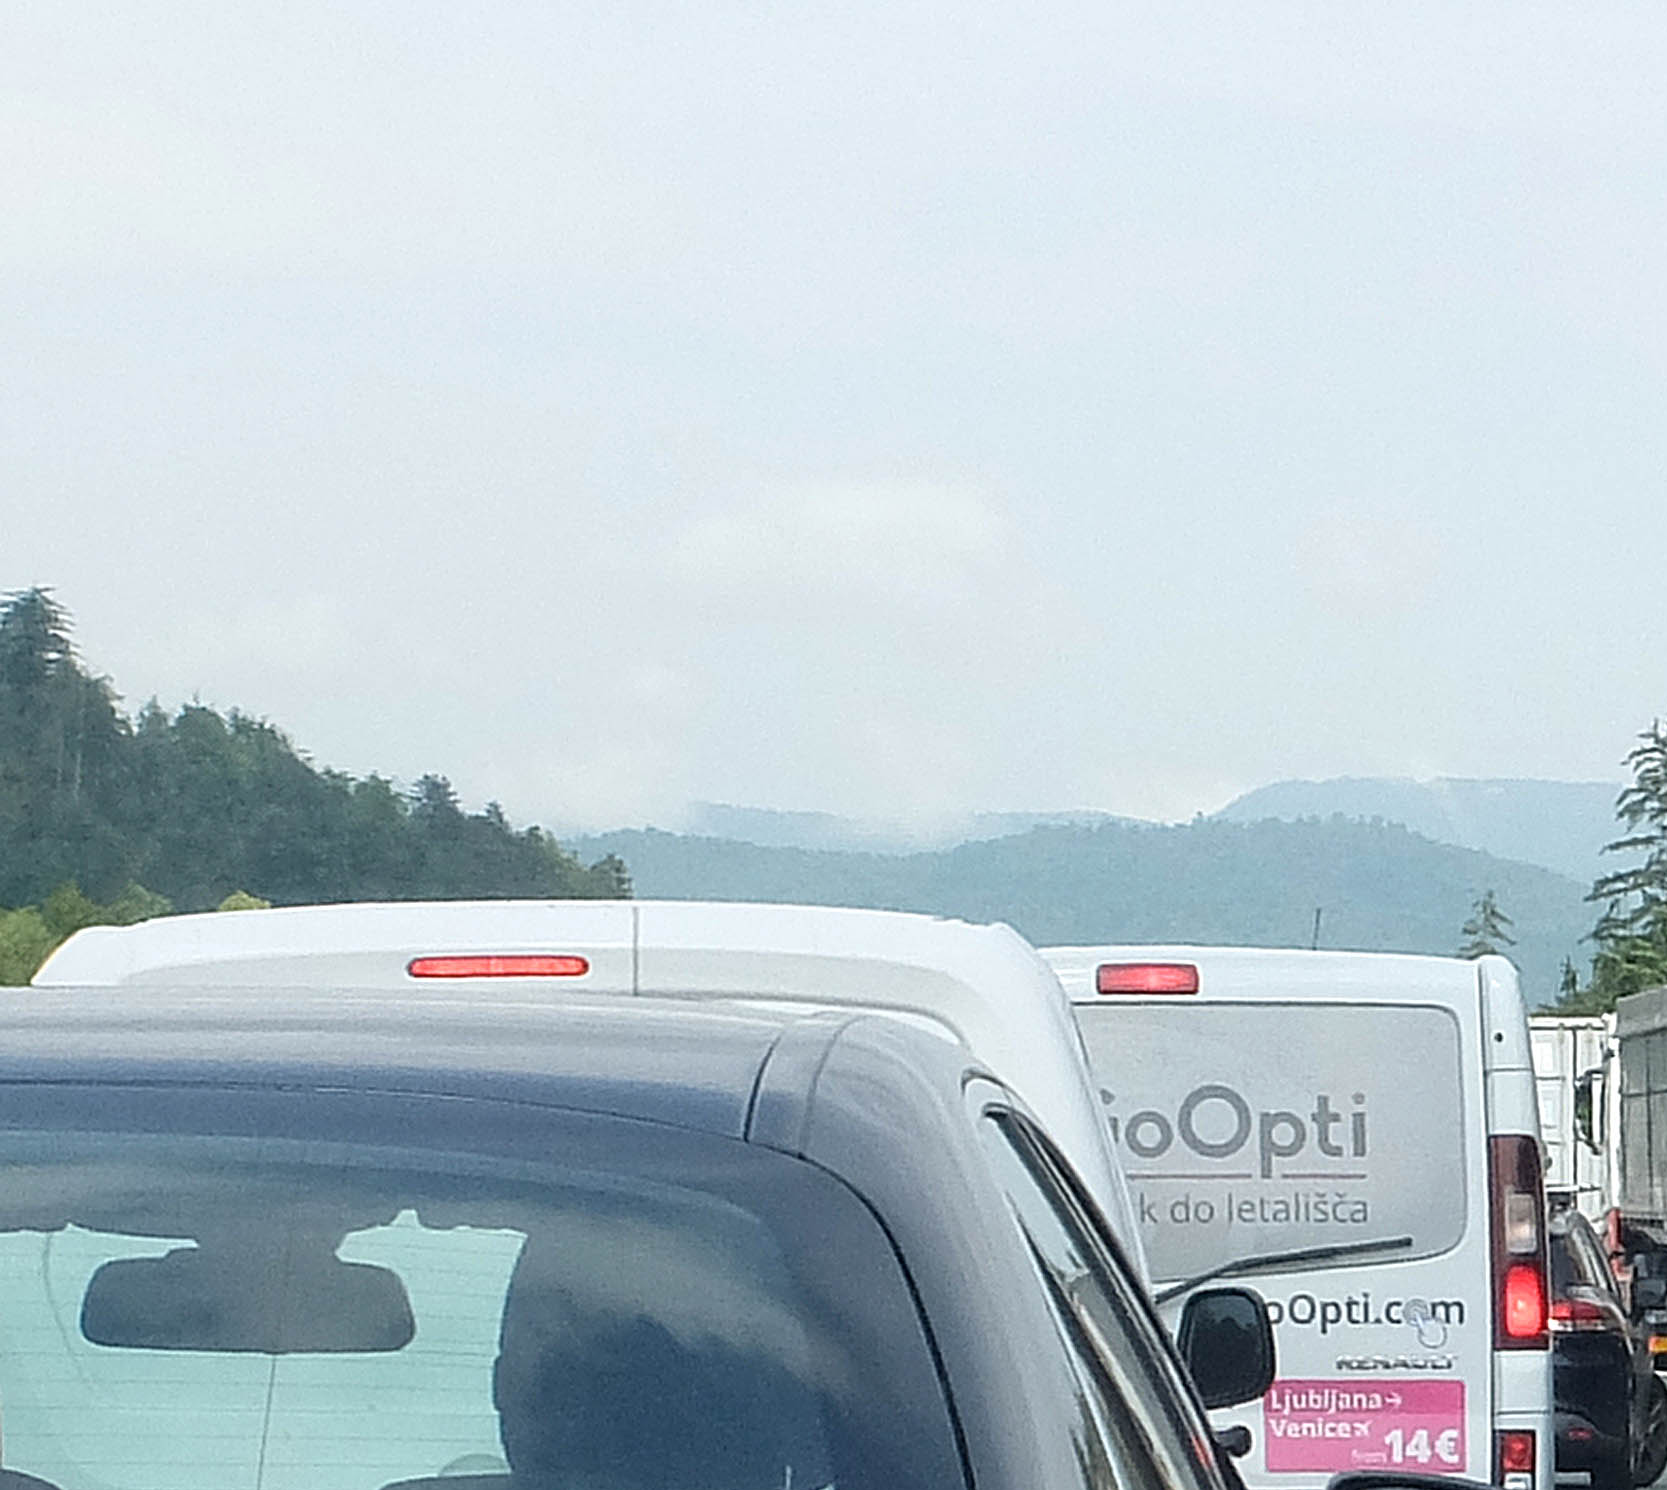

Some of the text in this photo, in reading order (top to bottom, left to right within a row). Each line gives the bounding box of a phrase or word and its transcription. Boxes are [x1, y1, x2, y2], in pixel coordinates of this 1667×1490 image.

[1100, 1084, 1367, 1179] oOpti
[1170, 1195, 1214, 1223] do
[1228, 1192, 1367, 1223] letališča
[1267, 1292, 1465, 1334] oOpti.com
[1271, 1390, 1382, 1415] Ljubljana
[1270, 1417, 1352, 1438] Venice
[1384, 1429, 1460, 1464] 14€
